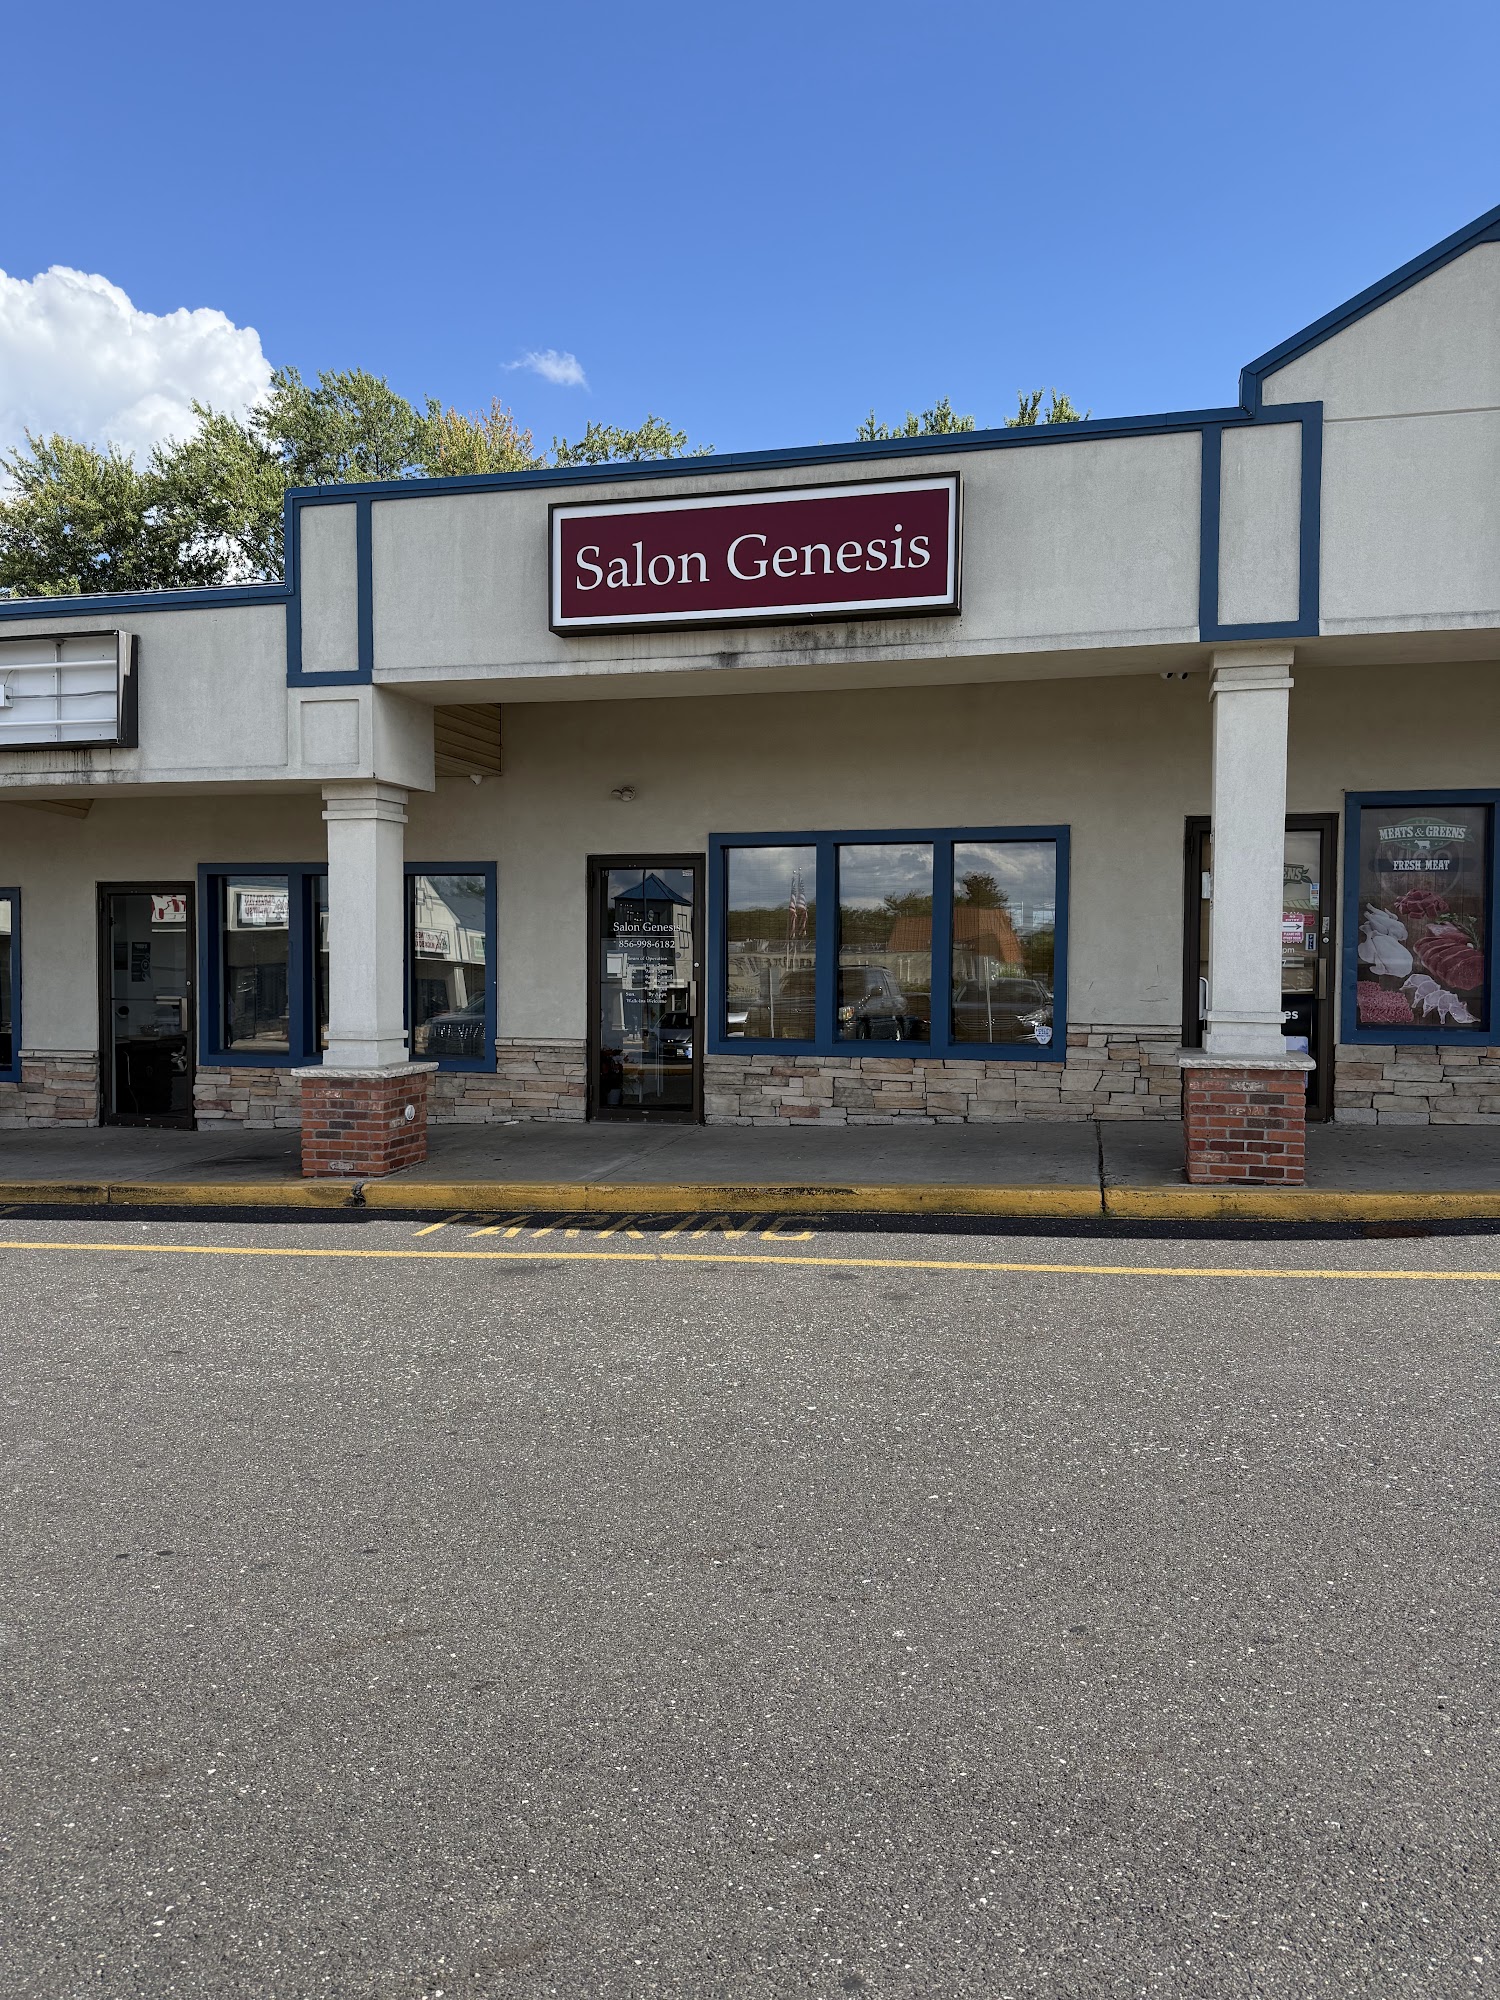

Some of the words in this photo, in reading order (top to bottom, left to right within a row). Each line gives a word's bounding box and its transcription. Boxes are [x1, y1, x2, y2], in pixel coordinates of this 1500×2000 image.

[575, 540, 710, 591] Salon
[726, 523, 931, 581] Genesis
[1378, 826, 1414, 841] MEATS
[1414, 827, 1425, 837] &
[1425, 825, 1467, 839] GREENS
[1393, 860, 1422, 871] FRESH
[1425, 860, 1450, 871] MEAT
[613, 921, 640, 932] Salon
[642, 921, 681, 932] Genesis
[618, 940, 676, 949] 856-998-6182
[411, 1213, 827, 1242] PARKING
